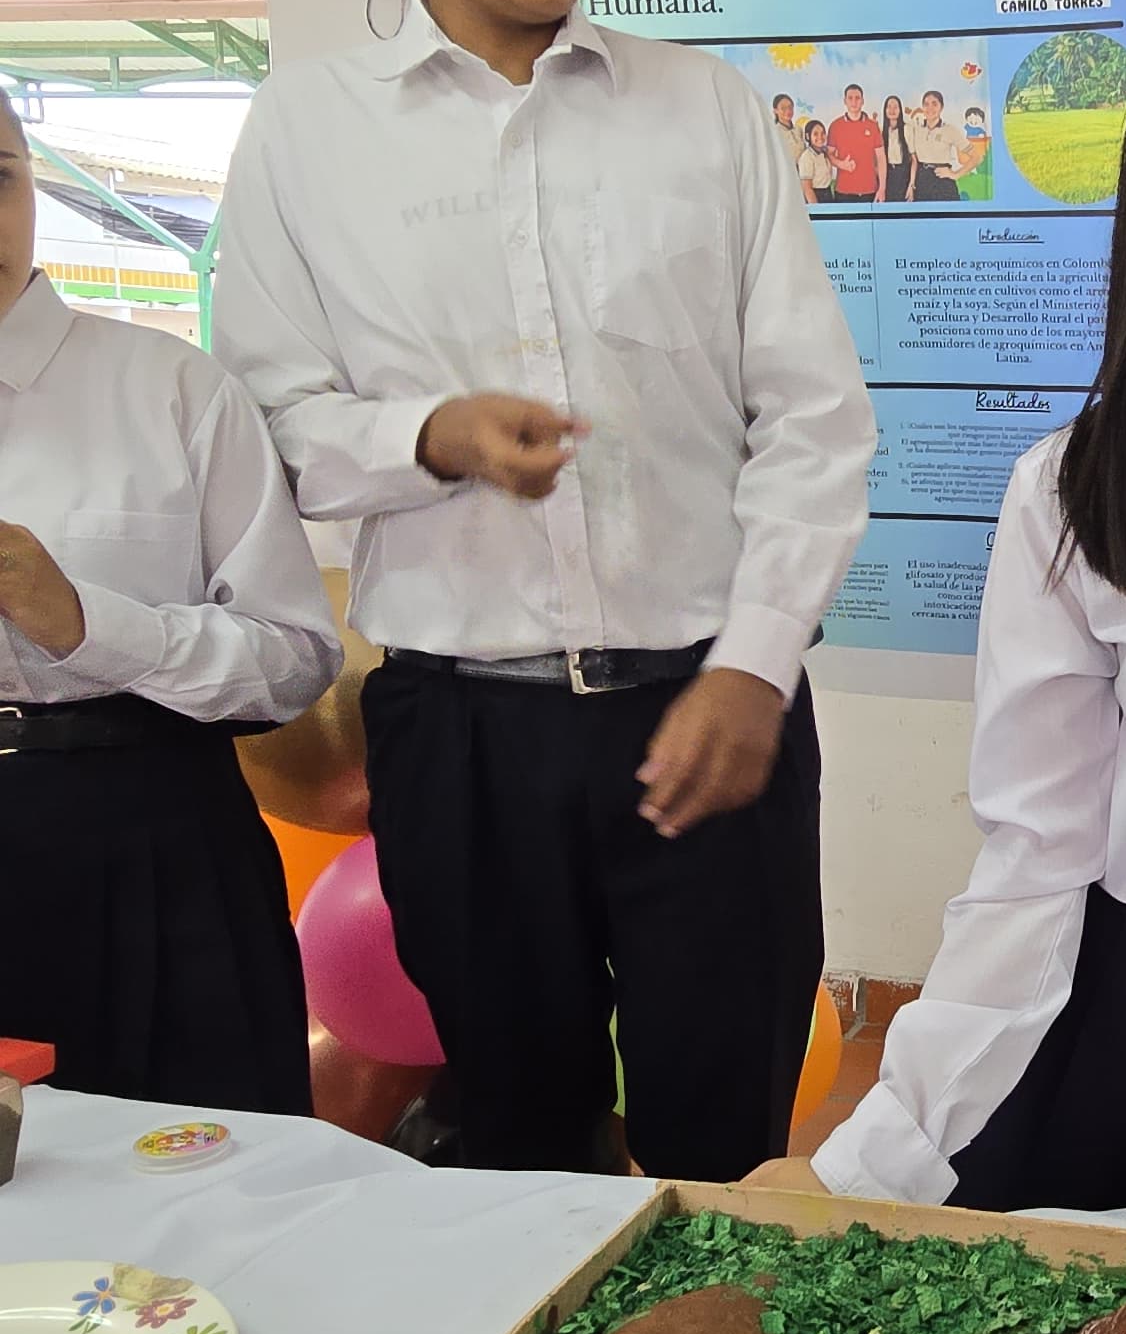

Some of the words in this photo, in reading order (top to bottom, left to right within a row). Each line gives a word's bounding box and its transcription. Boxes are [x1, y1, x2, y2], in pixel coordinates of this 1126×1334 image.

[895, 258, 907, 269] El
[910, 259, 951, 271] empleo
[954, 259, 967, 269] de
[1046, 261, 1060, 269] en
[905, 274, 926, 283] una
[974, 272, 1028, 282] extendida
[1046, 272, 1056, 282] la
[898, 285, 976, 298] especialmente
[994, 286, 1035, 296] cultivos
[1039, 288, 1071, 296] como
[1073, 286, 1083, 296] el
[943, 302, 950, 311] y
[953, 299, 962, 309] la
[1029, 299, 1039, 309] el
[1042, 299, 1100, 310] Ministerio
[907, 312, 970, 324] Agricultura
[973, 315, 980, 324] y
[982, 312, 1038, 323] Desarrollo
[1041, 313, 1071, 324] Rural
[1074, 313, 1084, 324] el
[920, 327, 971, 338] posiciona
[974, 328, 1004, 336] como
[1007, 328, 1028, 336] uno
[1030, 327, 1043, 336] de
[1046, 327, 1061, 337] los
[899, 338, 975, 348] consumidores
[978, 339, 990, 349] de
[1070, 342, 1083, 351] en
[976, 390, 1051, 410] Resultados
